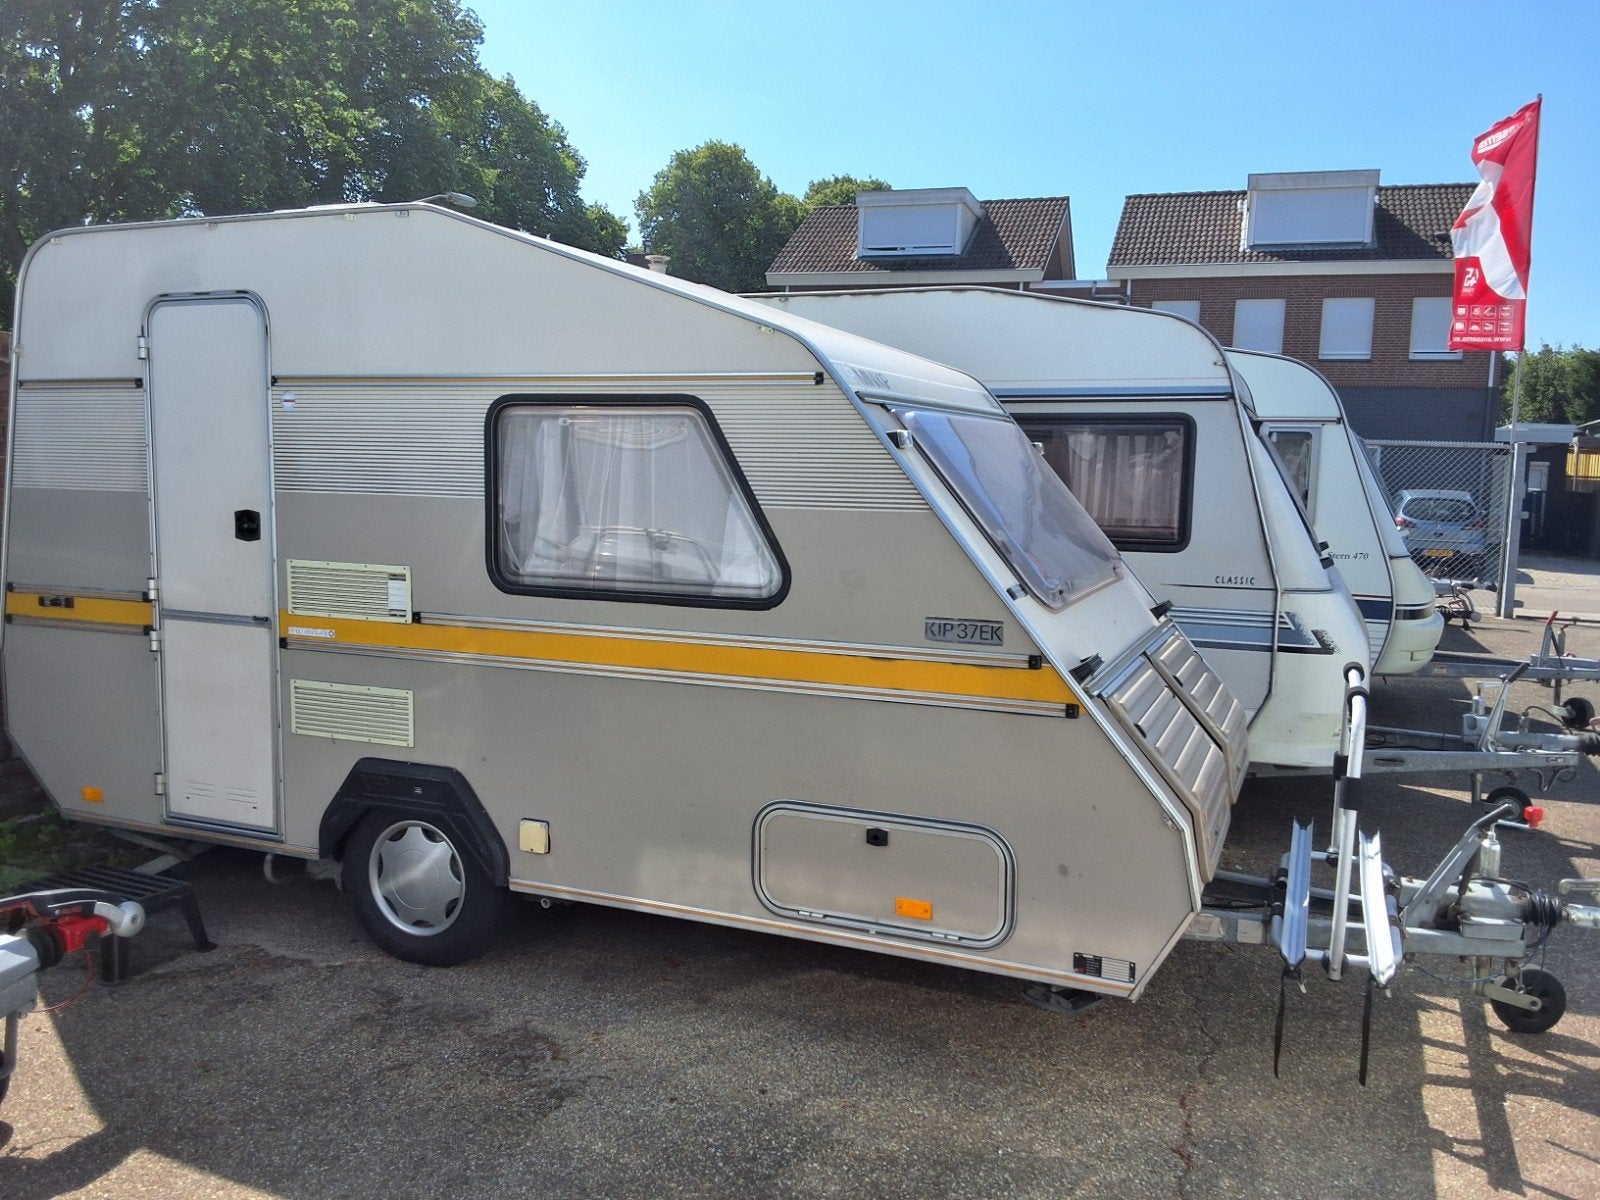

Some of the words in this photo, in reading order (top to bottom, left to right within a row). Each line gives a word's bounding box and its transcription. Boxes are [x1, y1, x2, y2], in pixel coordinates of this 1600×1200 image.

[1327, 551, 1350, 560] Stern
[1353, 552, 1369, 560] 470
[1215, 575, 1255, 586] CLASSIC
